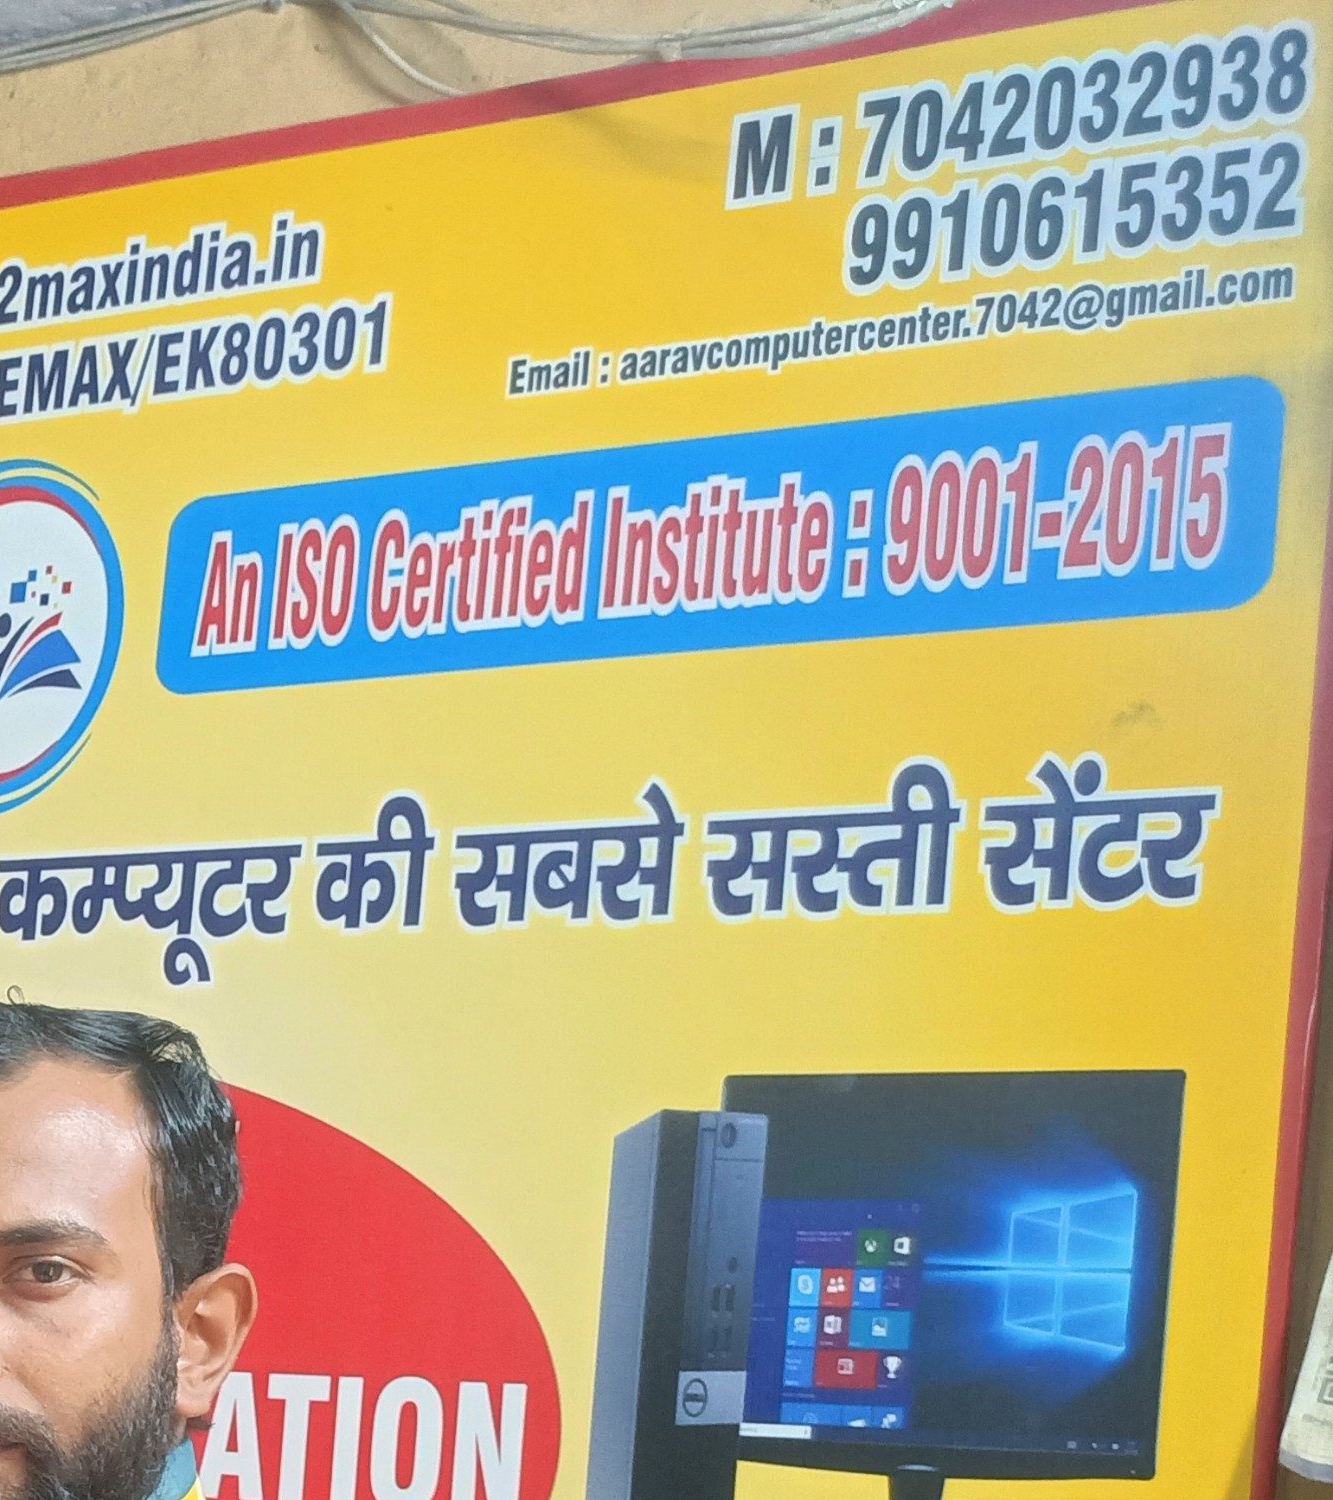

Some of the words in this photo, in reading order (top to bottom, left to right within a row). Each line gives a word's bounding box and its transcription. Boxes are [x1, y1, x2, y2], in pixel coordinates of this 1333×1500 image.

[733, 113, 793, 200] M
[813, 127, 833, 187] :
[863, 28, 1308, 178] 7042032938
[849, 142, 1300, 285] 9910615352
[509, 350, 590, 395] Email
[619, 268, 1293, 381] aaravcomputercenter.7042@gmail.com
[198, 533, 258, 648] An
[276, 519, 355, 641] ISO
[369, 497, 586, 632] Certified
[600, 484, 828, 608] Institute
[847, 500, 867, 588] :
[888, 433, 1228, 588] 9001-2015
[317, 797, 436, 929] की
[455, 783, 684, 927] सबसे
[708, 764, 961, 917] सस्ती
[984, 759, 1219, 906] सेंटर
